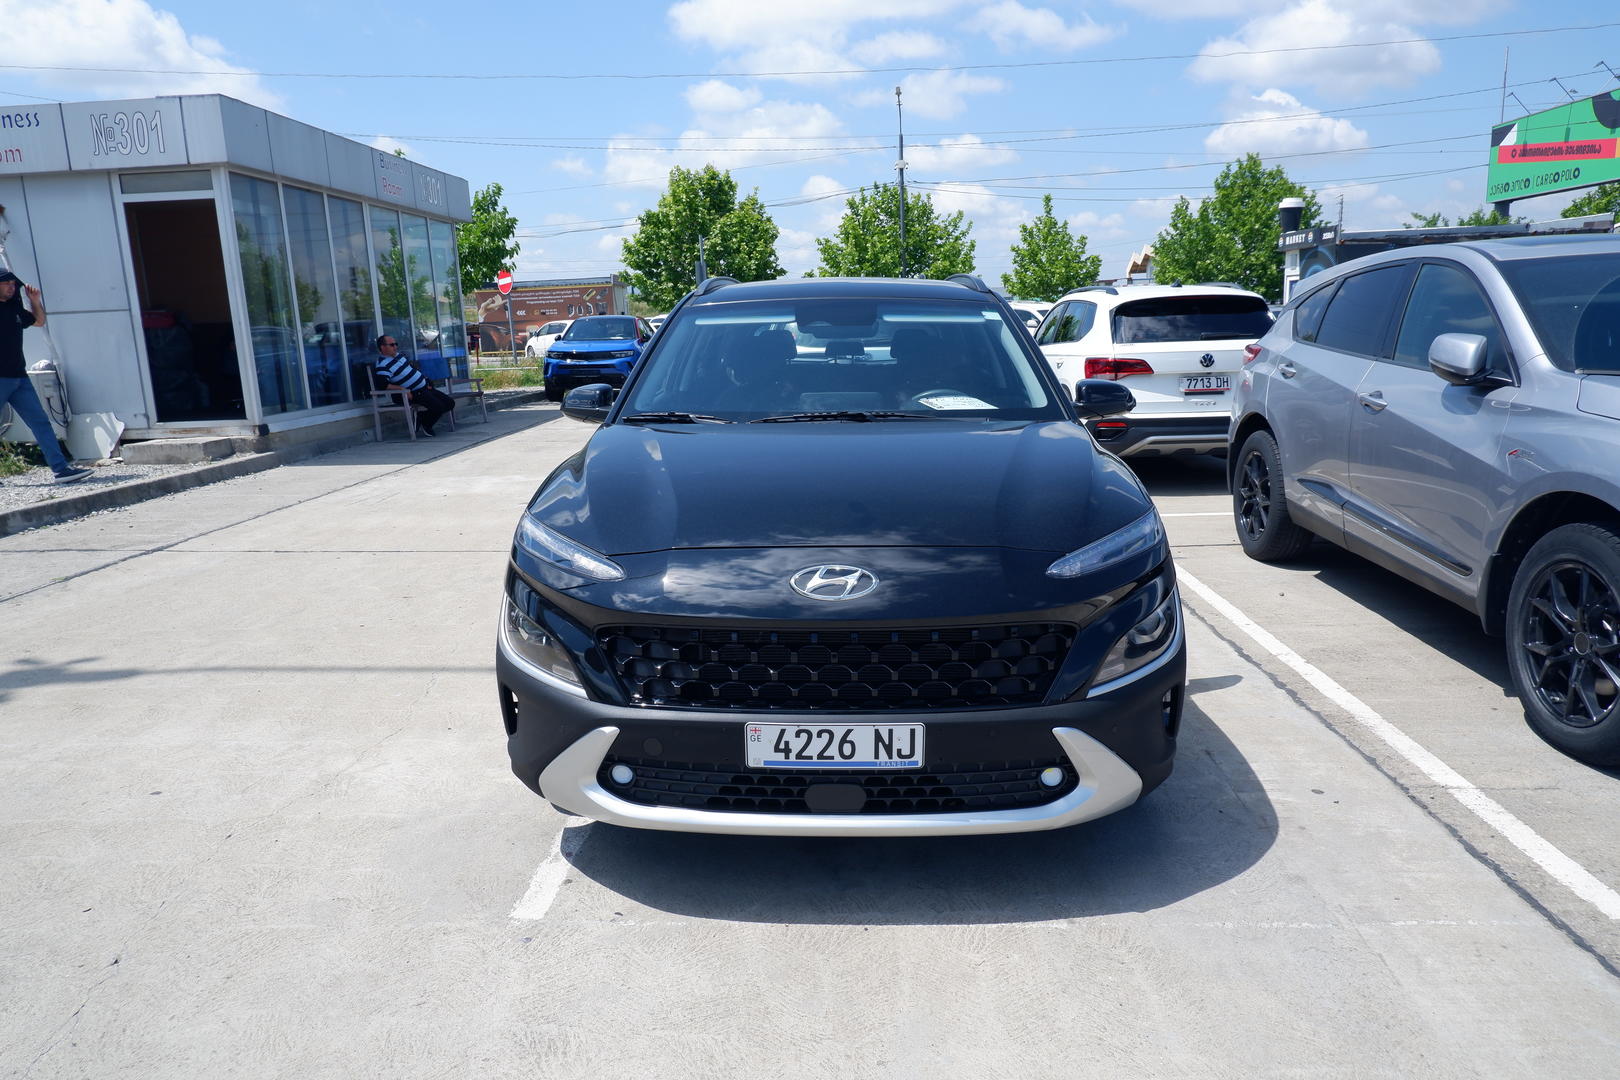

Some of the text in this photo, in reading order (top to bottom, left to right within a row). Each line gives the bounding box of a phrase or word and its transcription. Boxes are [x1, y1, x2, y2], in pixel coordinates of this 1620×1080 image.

[1186, 376, 1229, 389] 7713 DH
[750, 735, 762, 743] GE
[773, 728, 916, 760] 4226 NJ
